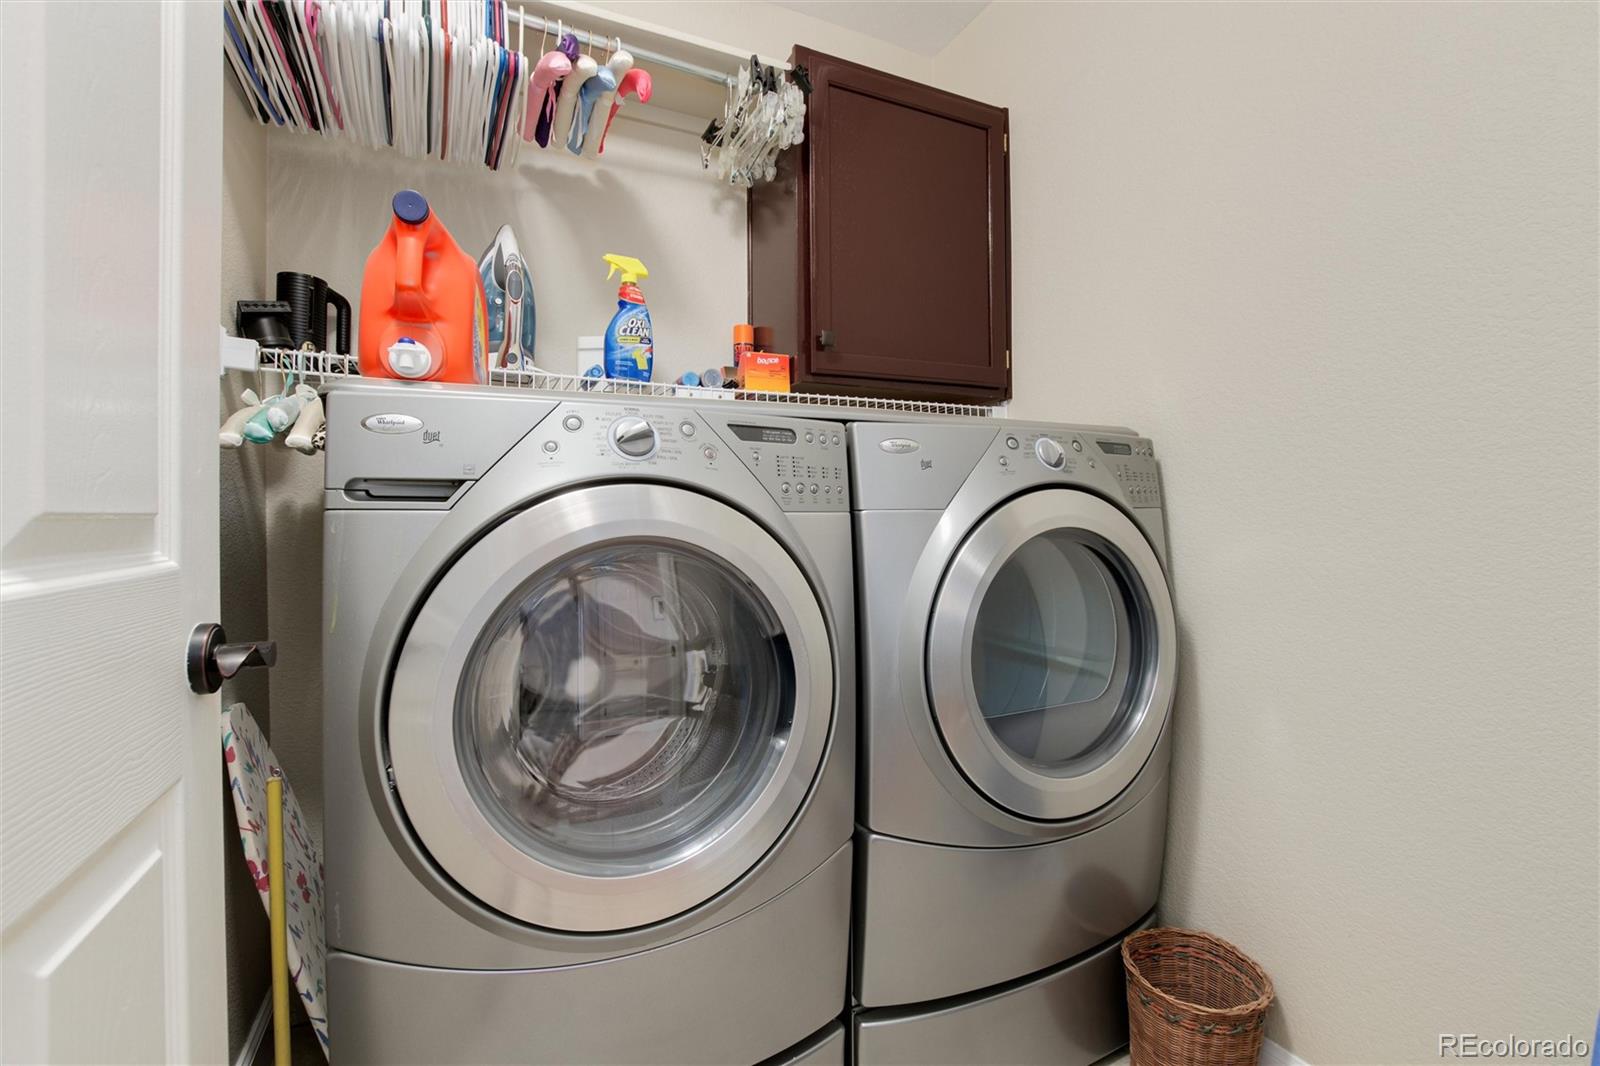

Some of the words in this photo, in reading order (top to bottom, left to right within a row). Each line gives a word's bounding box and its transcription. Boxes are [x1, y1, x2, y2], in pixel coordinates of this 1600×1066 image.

[628, 318, 645, 328] OXI
[619, 325, 649, 337] CLEAN
[423, 429, 441, 443] duet
